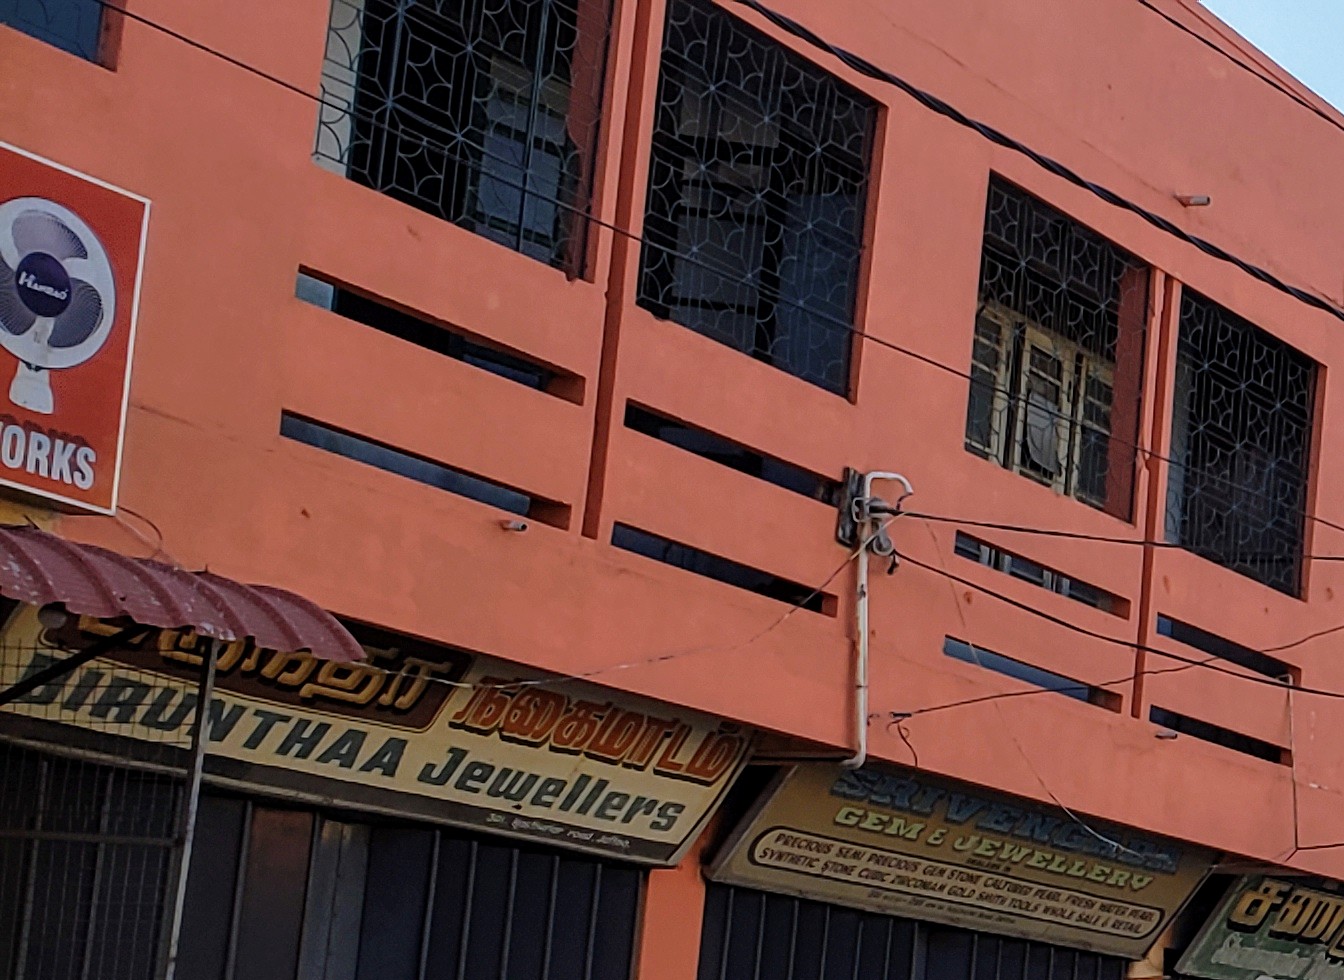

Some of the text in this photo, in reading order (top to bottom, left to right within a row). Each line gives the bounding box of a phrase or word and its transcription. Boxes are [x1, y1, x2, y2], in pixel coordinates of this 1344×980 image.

[0, 422, 97, 490] ORKS
[417, 747, 686, 832] Jewellers
[758, 847, 821, 869] SYNTHETIC
[947, 885, 976, 898] GOLD
[1008, 898, 1042, 914] TOOLS
[1110, 919, 1144, 934] RETAIL
[773, 833, 834, 855] PRECIOUS
[866, 853, 921, 872] PRECIOUS
[922, 865, 948, 878] GEM
[949, 869, 981, 885] STONE
[834, 806, 926, 841] GEM
[953, 835, 1153, 891] JEWELLERY
